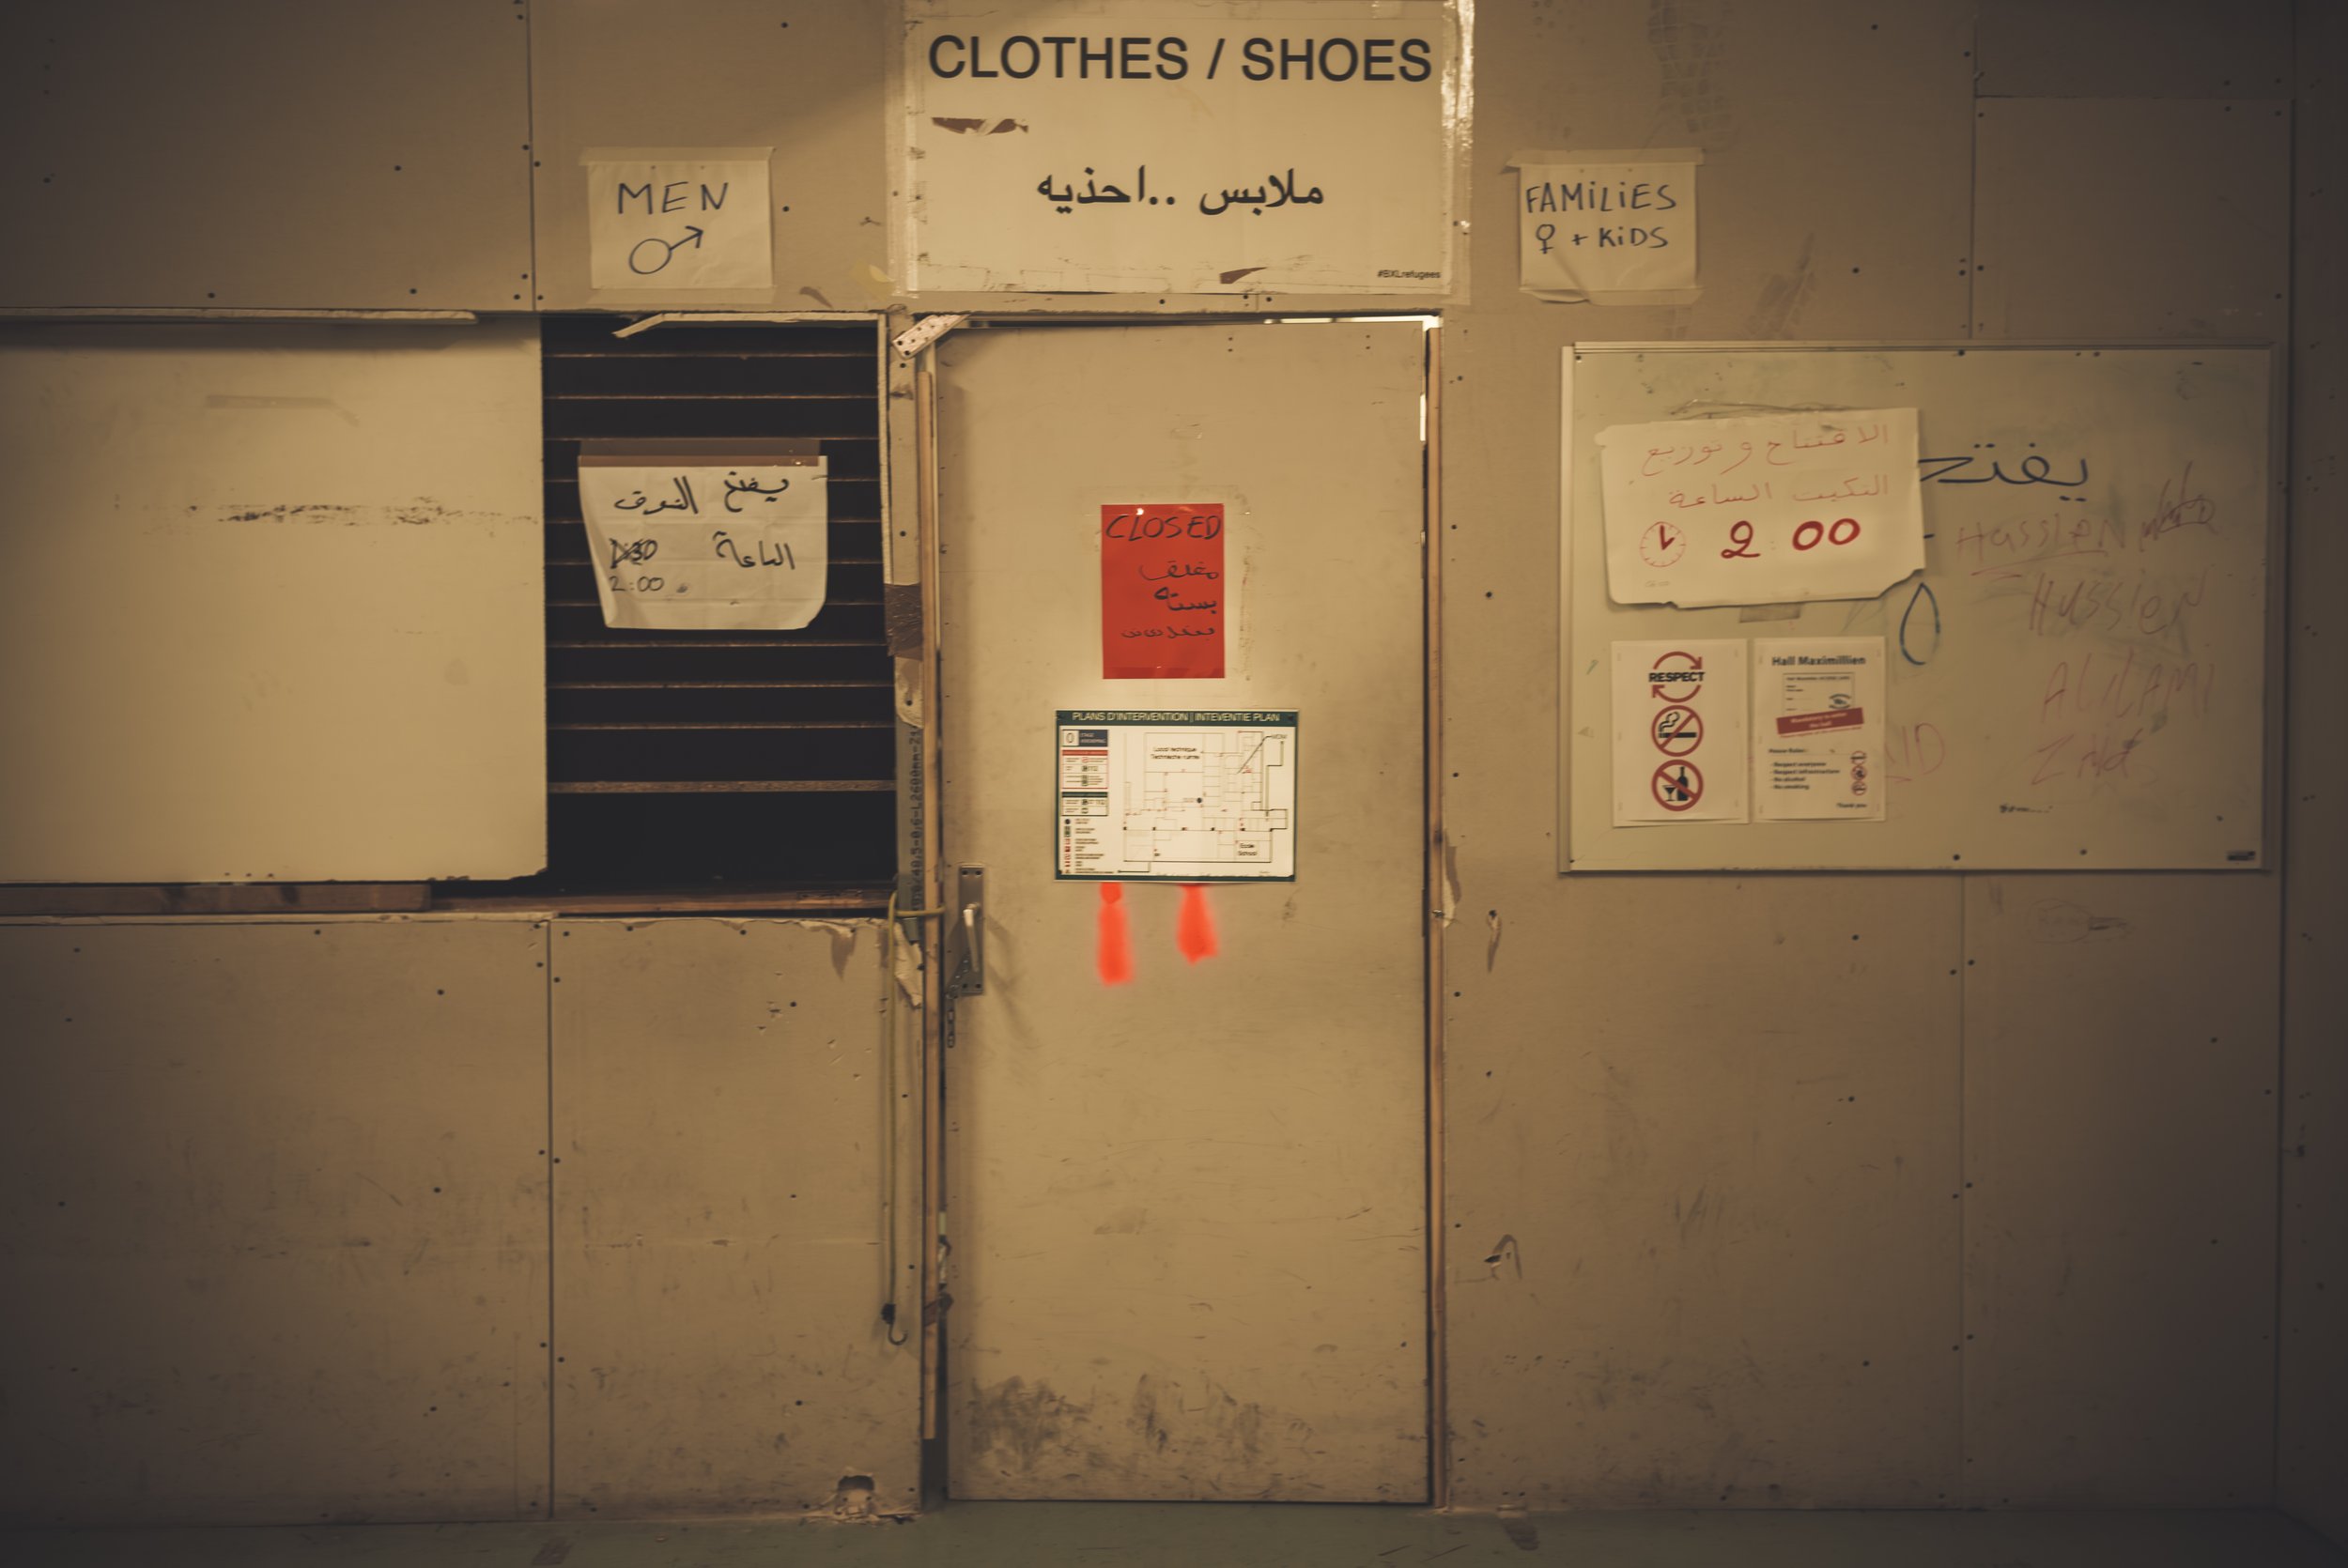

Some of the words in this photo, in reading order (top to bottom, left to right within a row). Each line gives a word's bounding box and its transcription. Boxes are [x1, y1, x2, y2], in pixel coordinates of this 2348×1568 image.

[928, 35, 1188, 81] CLOTHES
[1206, 38, 1225, 80] /
[1241, 38, 1432, 82] SHOES
[618, 180, 729, 215] MEN
[1199, 167, 1325, 216] ملابس
[1669, 482, 1772, 509] الساعة
[1104, 515, 1221, 542] CLOSED
[1771, 656, 1796, 666] Hall
[1648, 671, 1705, 683] RESPECT
[1072, 712, 1105, 721] PLANS
[1253, 712, 1280, 721] PLAN
